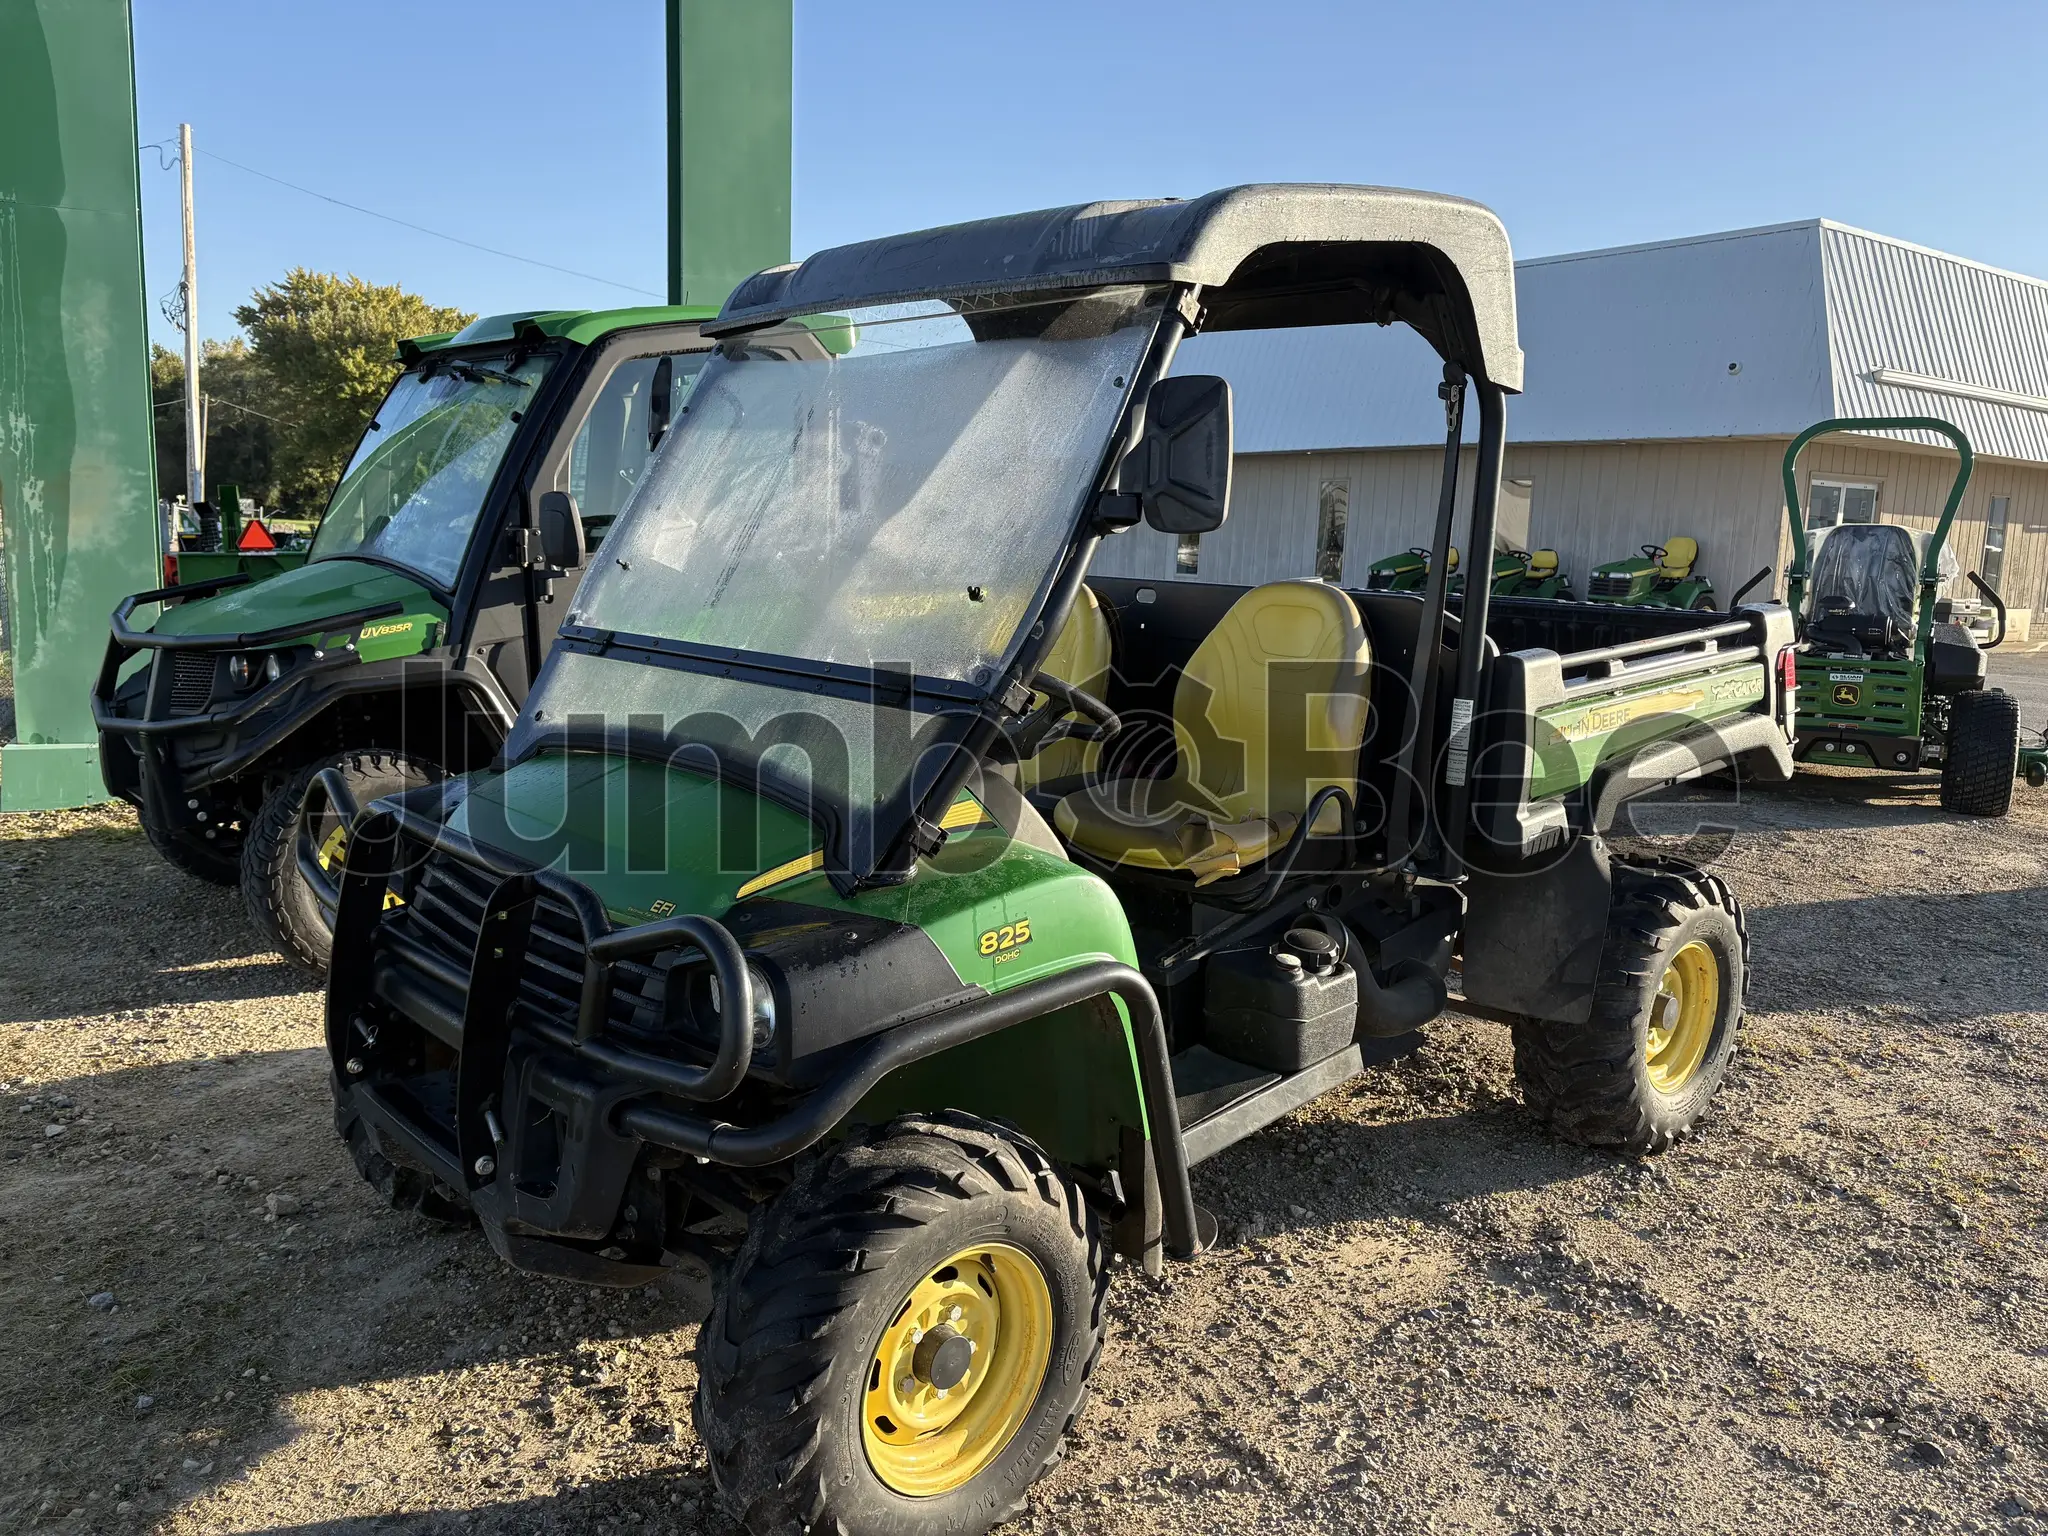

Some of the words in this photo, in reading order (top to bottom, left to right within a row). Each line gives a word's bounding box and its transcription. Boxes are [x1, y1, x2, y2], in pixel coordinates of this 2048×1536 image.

[346, 622, 413, 643] UV835R
[1591, 707, 1631, 731] DEERE
[650, 899, 677, 917] EFI
[980, 919, 1030, 955] 825
[995, 949, 1020, 965] DOHC
